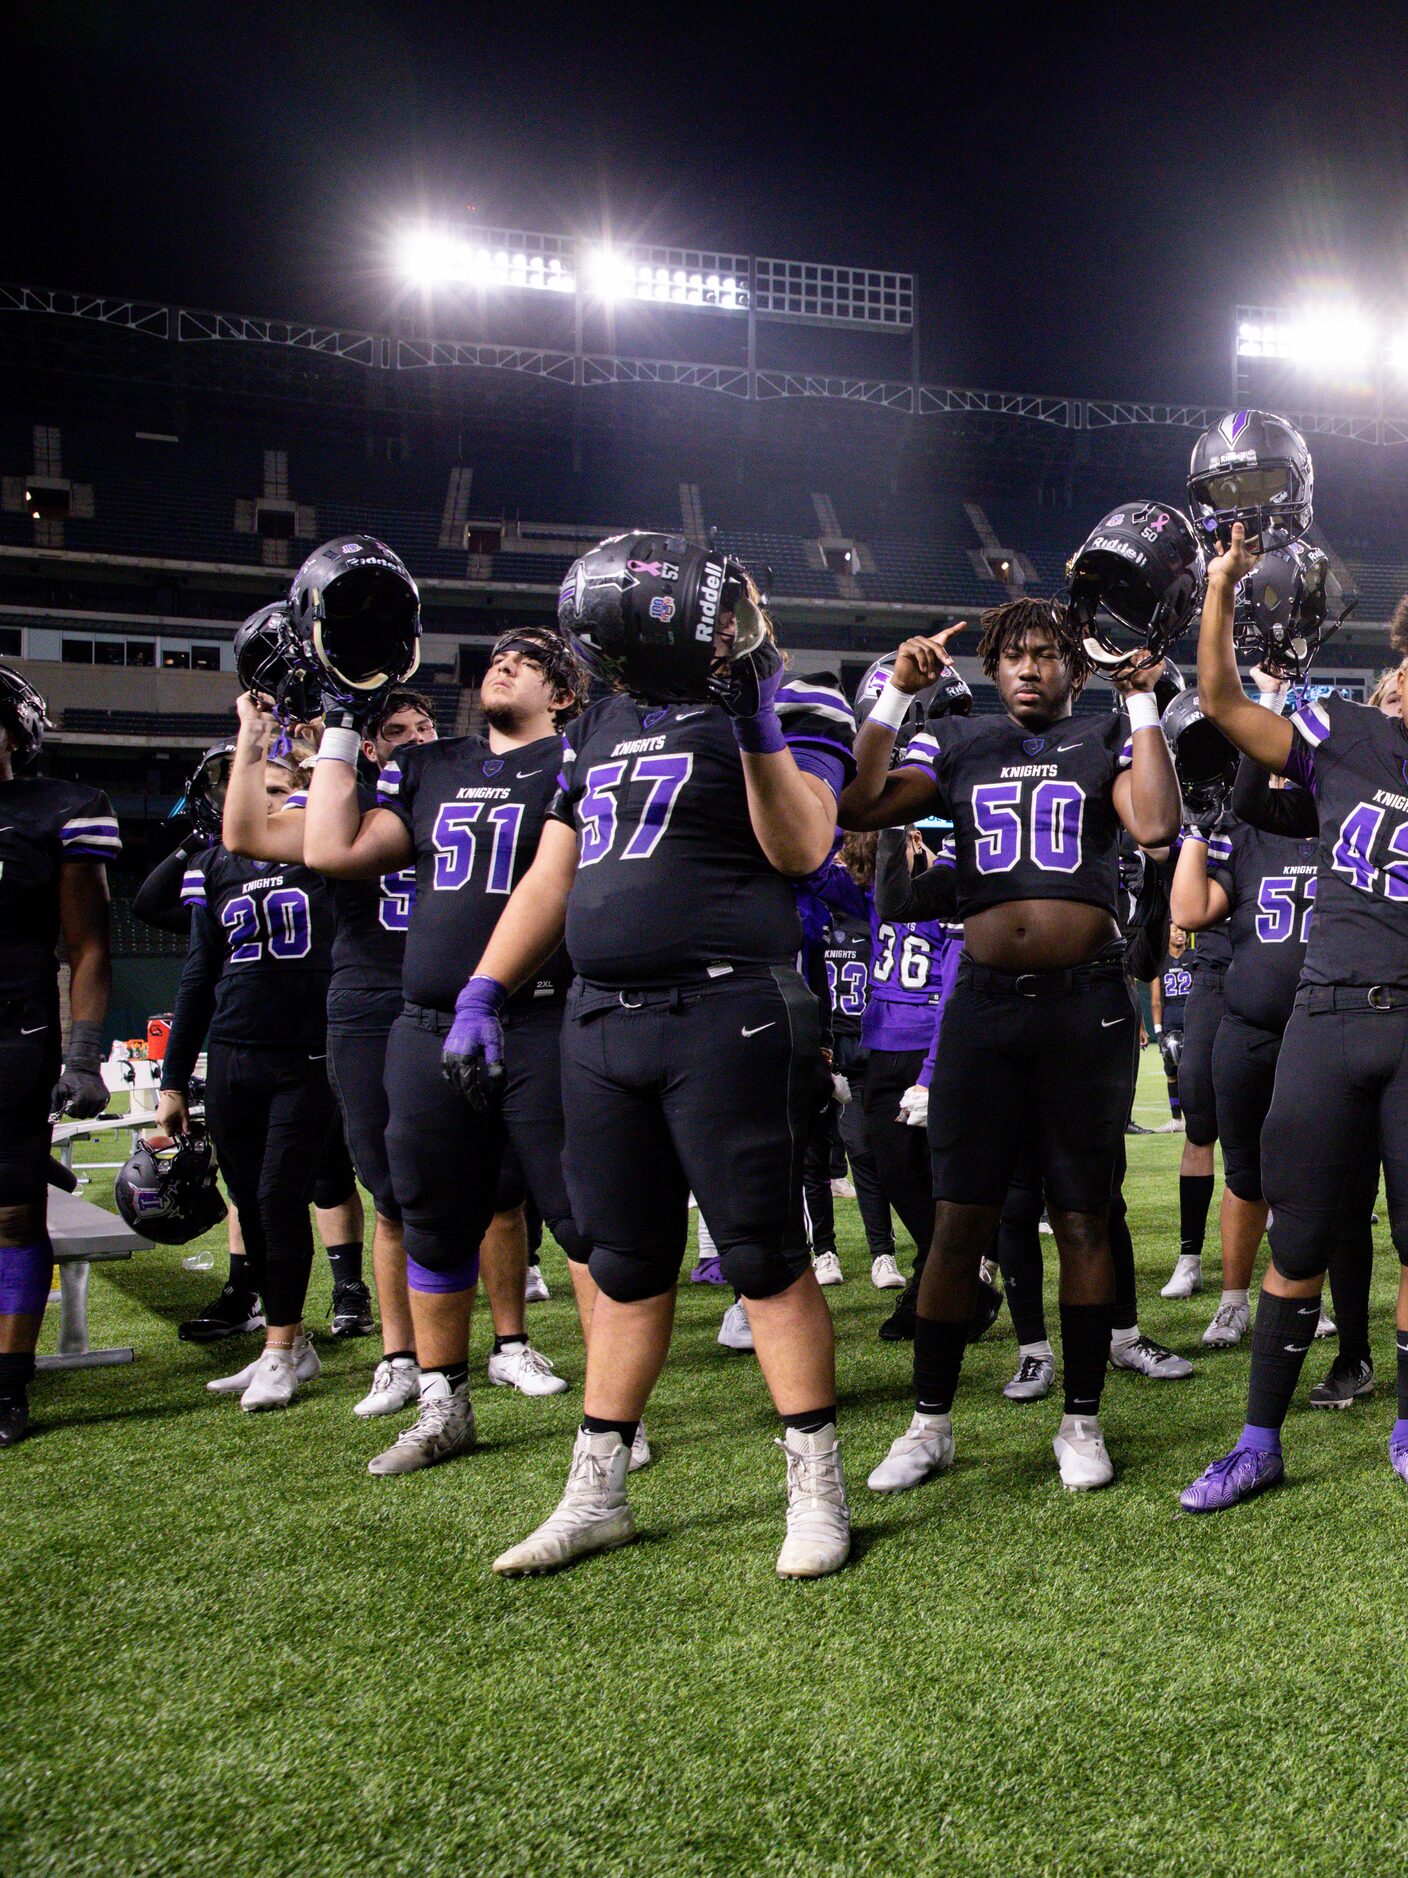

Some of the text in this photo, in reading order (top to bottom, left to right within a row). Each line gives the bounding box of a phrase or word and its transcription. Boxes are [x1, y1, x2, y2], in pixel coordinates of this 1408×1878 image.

[1140, 527, 1159, 543] 50
[1092, 537, 1147, 567] Riddell
[661, 562, 679, 580] 57
[696, 561, 723, 642] Riddell
[611, 735, 667, 757] KNIGHTS
[1000, 764, 1058, 778] KNIGHTS
[456, 788, 511, 799] KNIGHTS
[577, 752, 694, 869] 57
[971, 780, 1086, 875] 50
[432, 802, 526, 895] 51
[1282, 866, 1318, 875] KNIGHT
[242, 876, 284, 893] KNIGHTS
[221, 887, 312, 963] 20
[824, 950, 856, 959] KNIGHTS
[872, 923, 931, 989] 36
[536, 980, 553, 988] 2XL
[1164, 971, 1192, 996] 22
